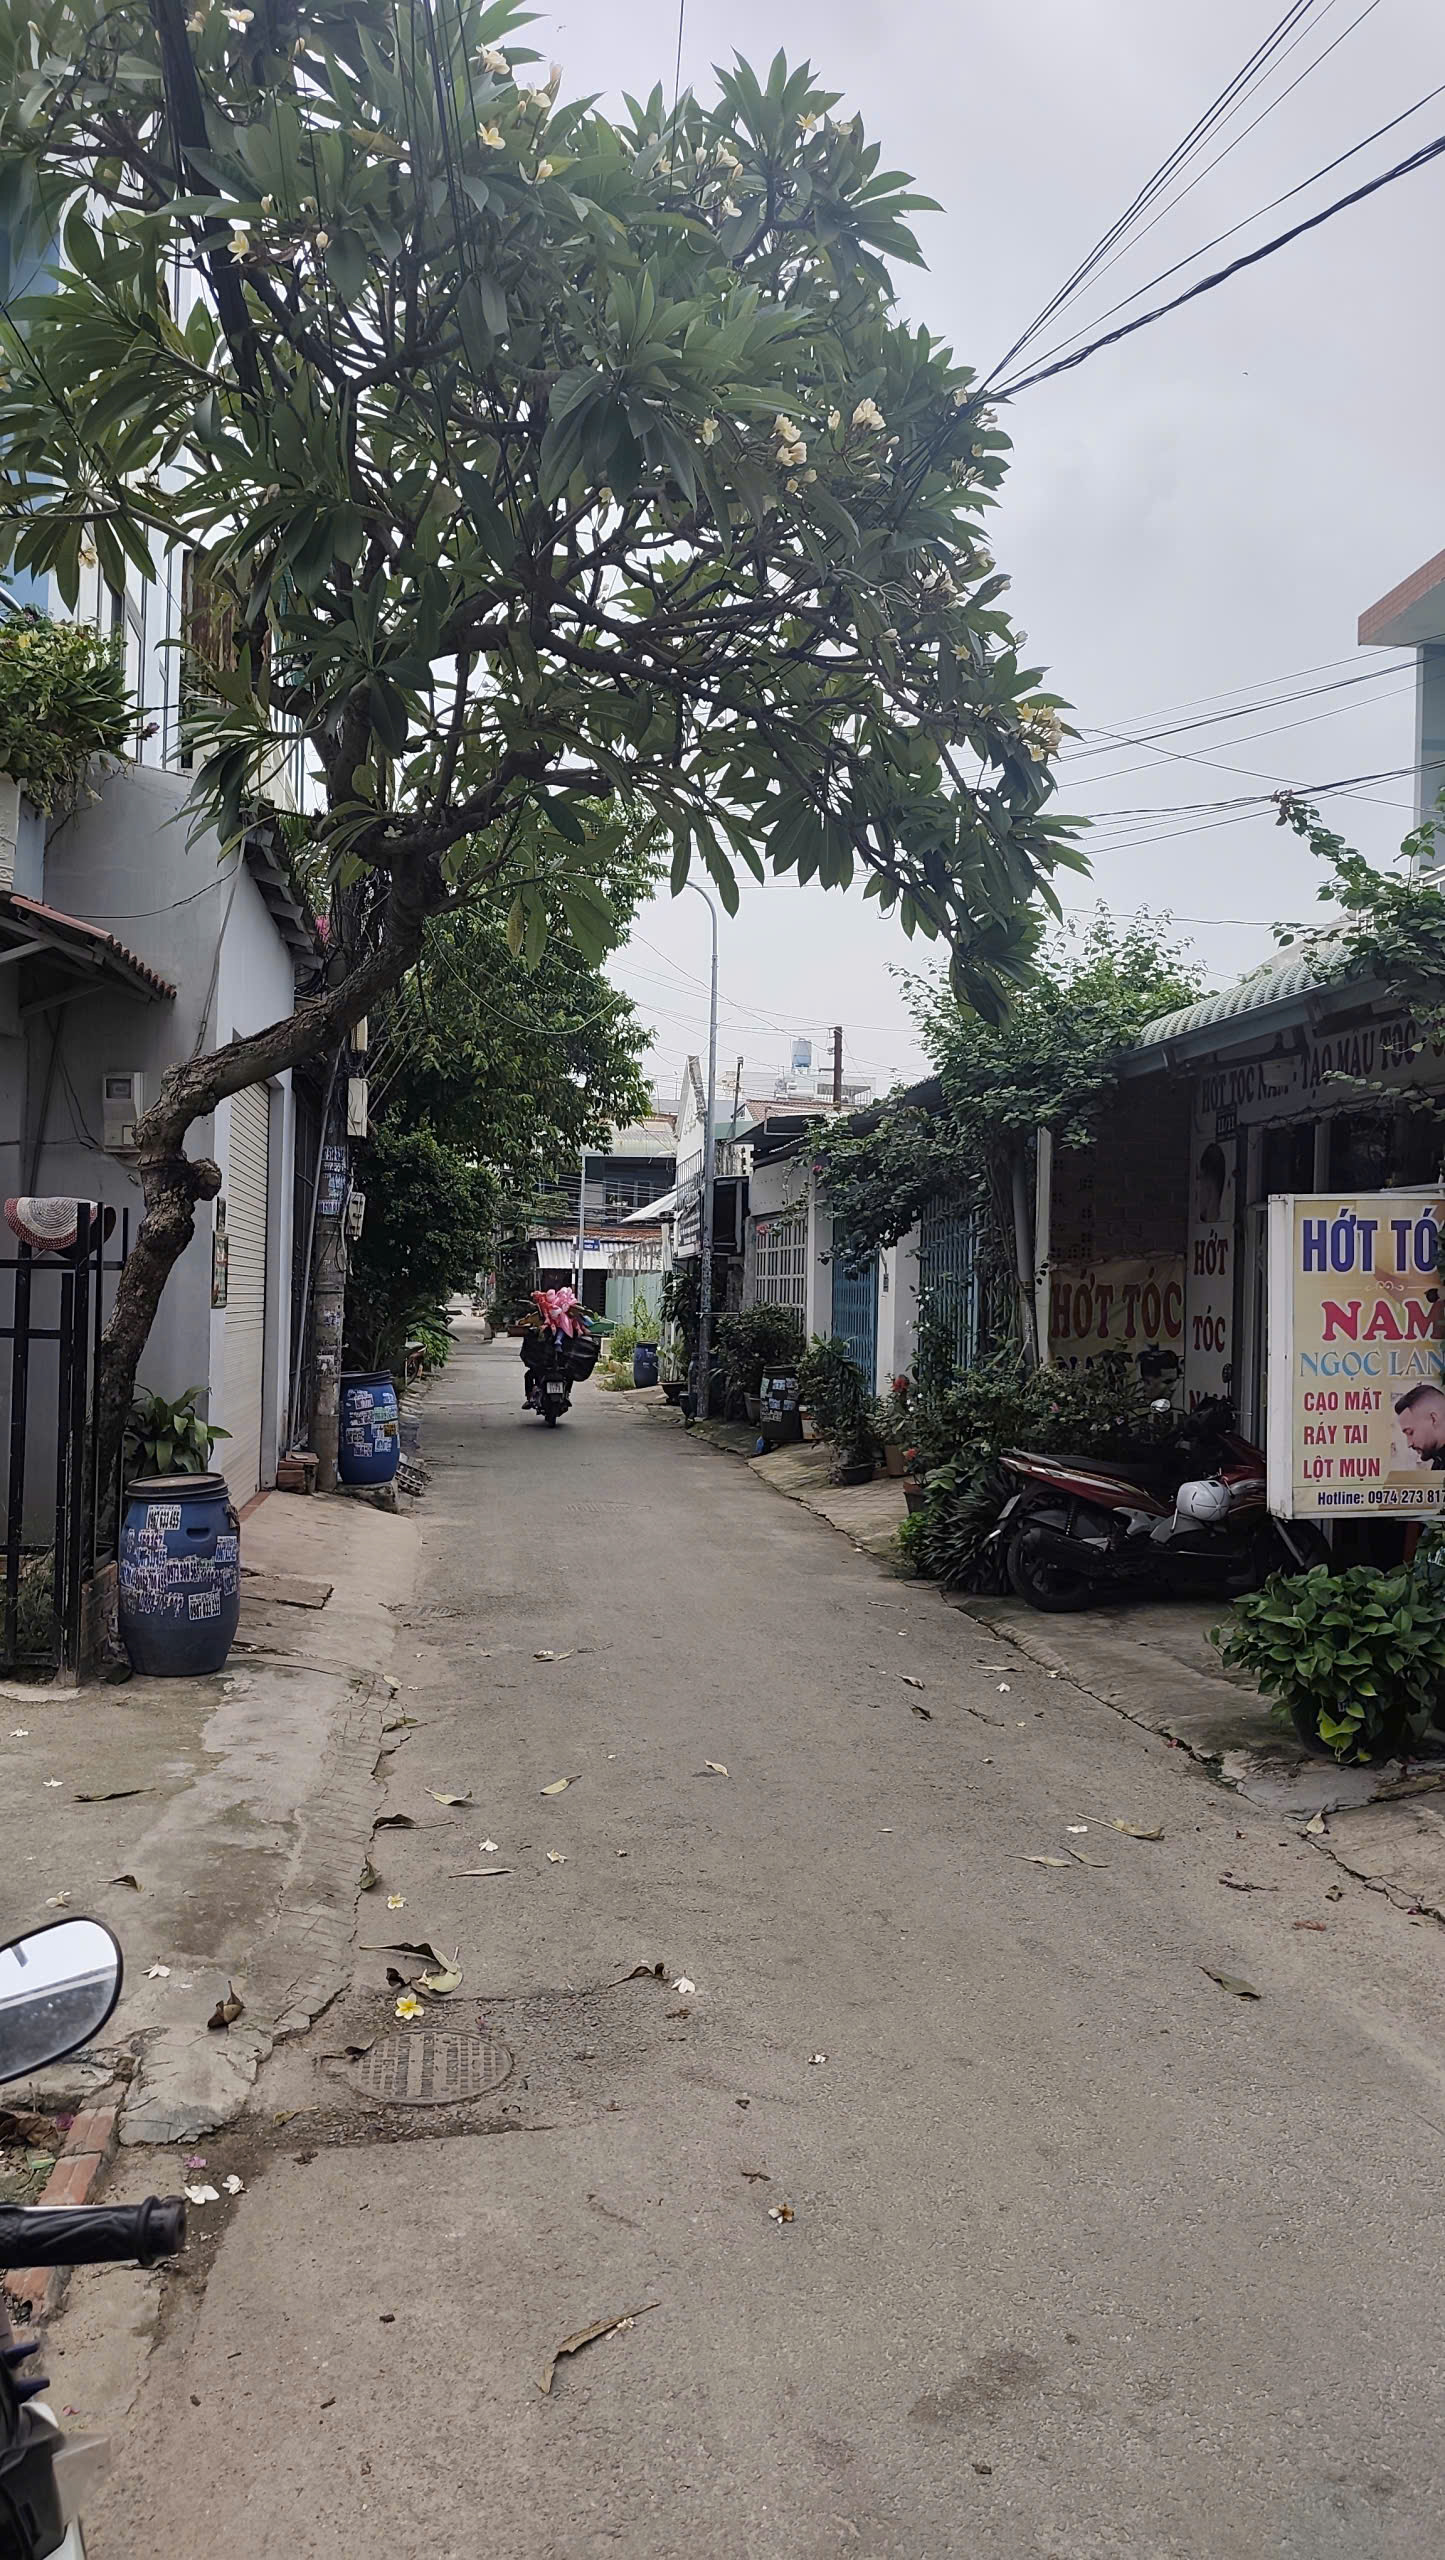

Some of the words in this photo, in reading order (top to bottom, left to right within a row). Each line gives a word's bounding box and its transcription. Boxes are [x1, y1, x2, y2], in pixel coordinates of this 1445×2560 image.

[1193, 1229, 1228, 1275] HỚT
[1302, 1208, 1378, 1272] HỚT
[1391, 1208, 1440, 1272] TÓ
[1051, 1268, 1114, 1338] HỚT
[1122, 1267, 1183, 1338] TÓC
[1192, 1305, 1226, 1352] TÓC
[1321, 1300, 1445, 1341] NAM
[1300, 1351, 1382, 1381] NGỌC
[1304, 1391, 1338, 1415] CẠO
[1344, 1387, 1382, 1414] MẶT
[1303, 1422, 1337, 1445] RÁY
[1343, 1425, 1368, 1443] TAI
[1303, 1456, 1333, 1482] LỘT
[1340, 1458, 1380, 1482] MỤN
[1317, 1492, 1364, 1505] Hotline:
[1368, 1490, 1397, 1504] 0974
[1401, 1490, 1423, 1503] 273
